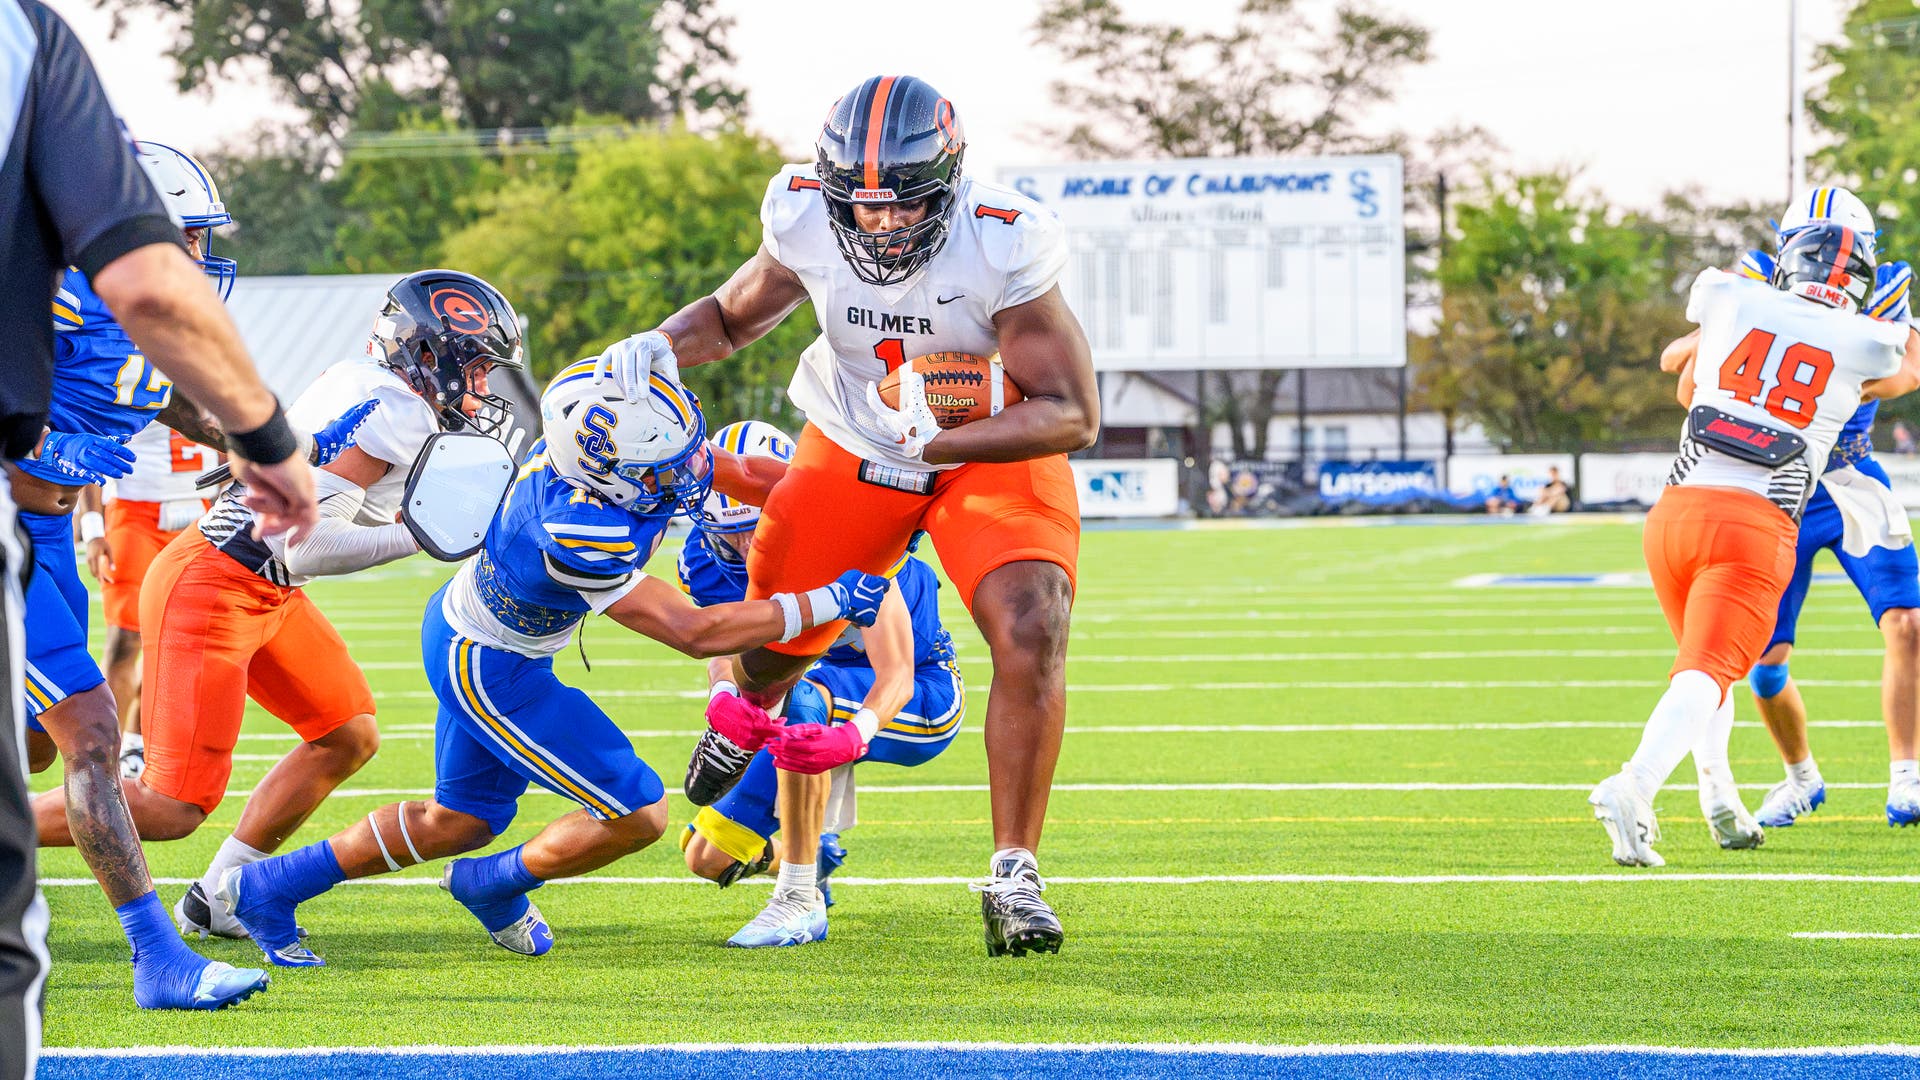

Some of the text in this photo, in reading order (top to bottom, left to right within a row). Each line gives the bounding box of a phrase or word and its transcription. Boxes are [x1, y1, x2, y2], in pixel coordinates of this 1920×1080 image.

[855, 191, 893, 199] BUCKEYES
[975, 203, 1023, 226] 1
[1806, 284, 1849, 310] GILMER
[847, 306, 935, 335] GILMER
[873, 338, 906, 375] 1
[1718, 327, 1835, 430] 48
[927, 393, 977, 407] Wilson
[722, 507, 751, 517] WILDCATS
